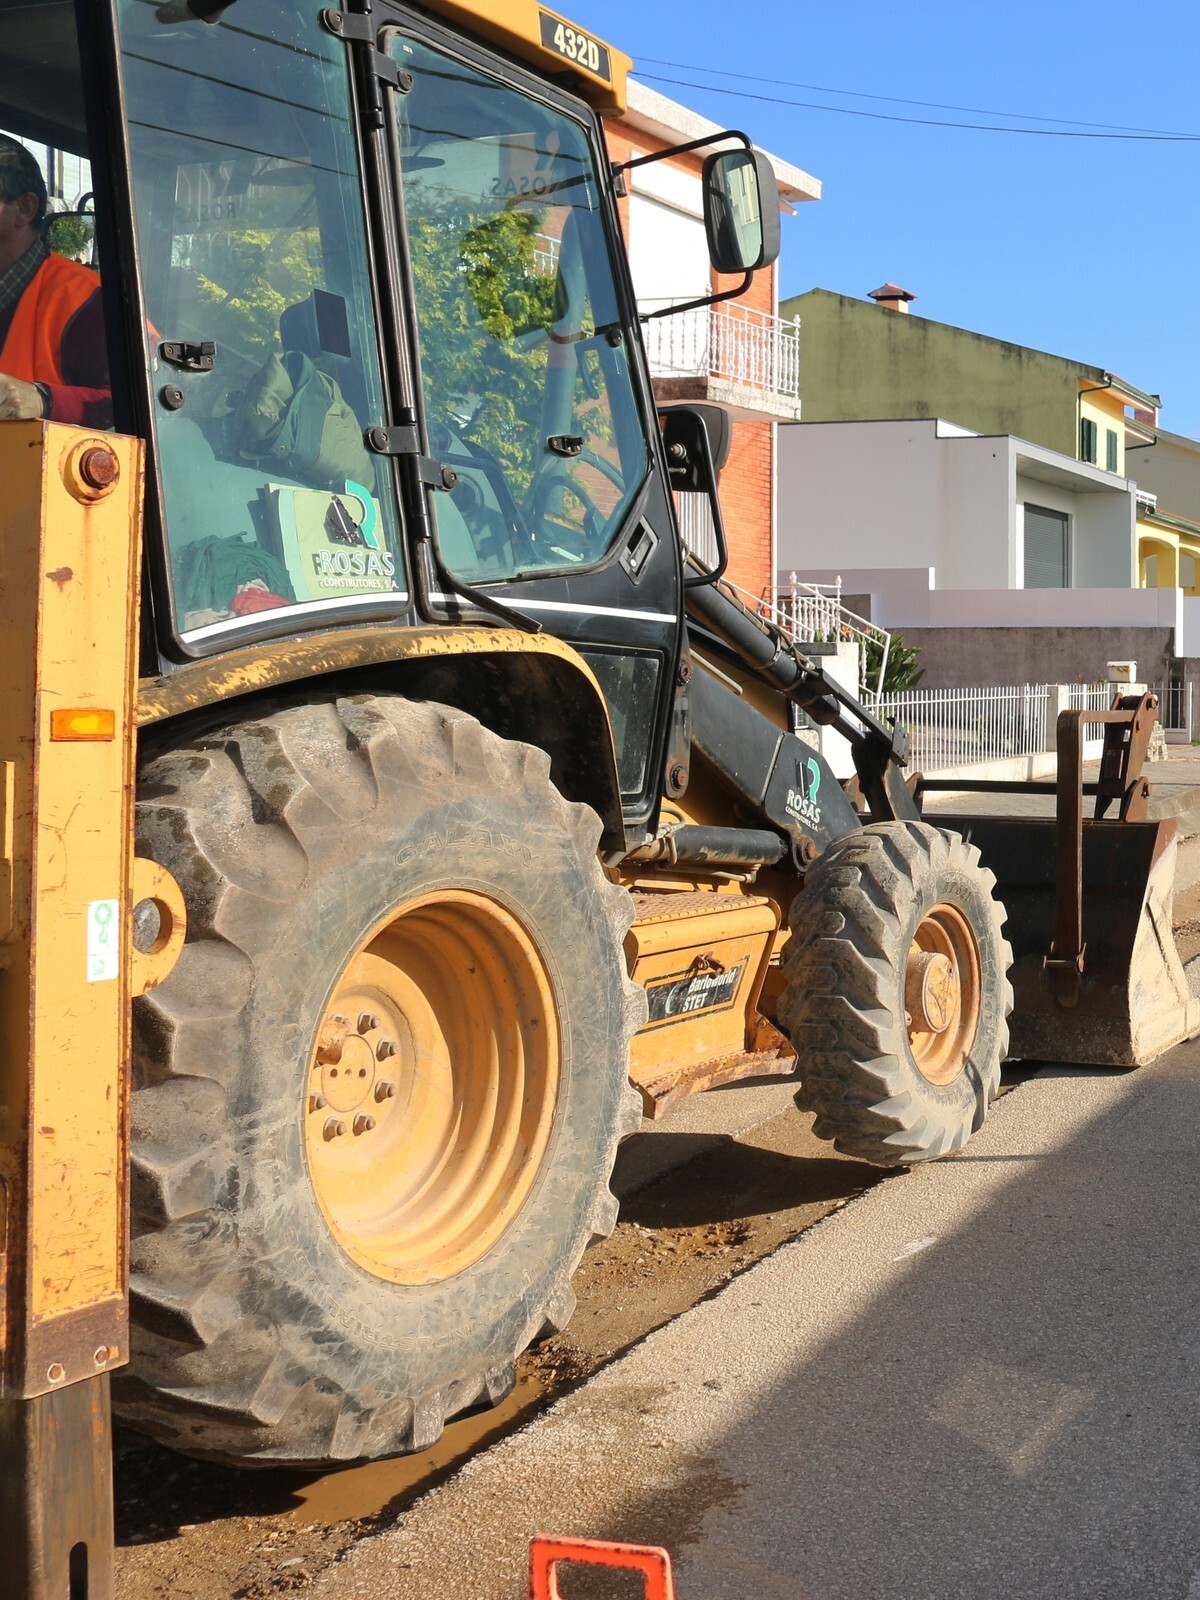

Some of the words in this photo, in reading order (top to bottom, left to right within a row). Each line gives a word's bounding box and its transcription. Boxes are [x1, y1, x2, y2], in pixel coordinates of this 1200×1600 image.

[554, 23, 599, 71] 432D
[320, 549, 395, 576] ROSAS
[323, 577, 384, 589] CONSTRUTORES,
[786, 789, 821, 823] ROSAS
[682, 993, 708, 1012] STET
